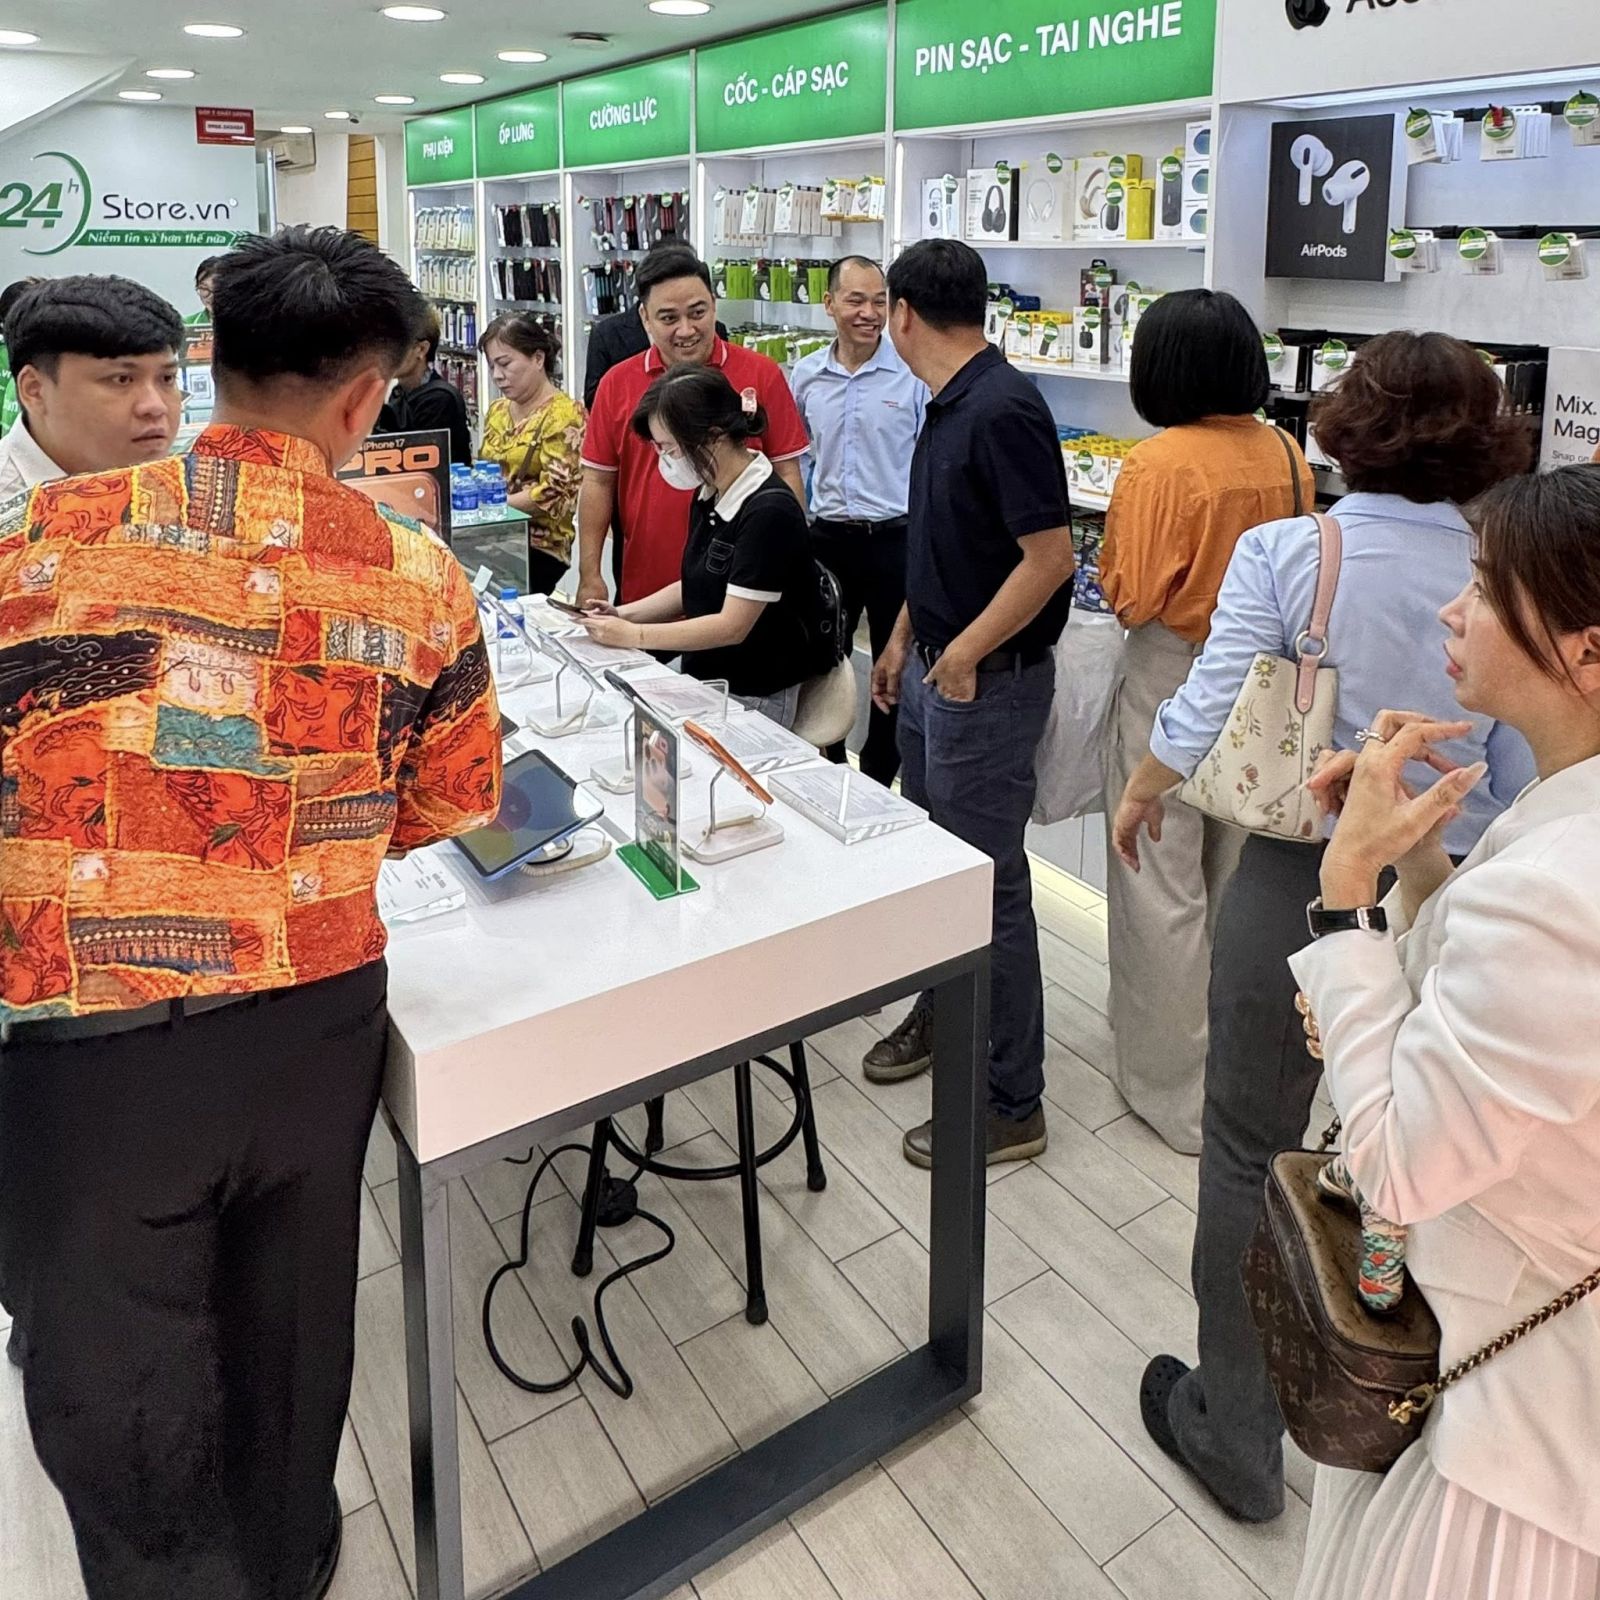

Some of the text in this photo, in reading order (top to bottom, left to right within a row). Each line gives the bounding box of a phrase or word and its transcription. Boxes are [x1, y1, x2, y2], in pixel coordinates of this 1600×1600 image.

[915, 43, 954, 76] PIN
[960, 32, 1013, 74] SẠC
[1035, 19, 1080, 57] TAI
[1088, 1, 1182, 50] NGHE
[724, 71, 759, 106] CỐC
[772, 65, 807, 98] CÁP
[811, 61, 849, 96] SẠC
[589, 96, 657, 130] CƯỜNG LỰC
[499, 122, 510, 145] ỐP
[125, 232, 140, 243] tin
[1300, 244, 1347, 258] AirPods
[1556, 394, 1597, 416] Mix.
[364, 438, 405, 450] iPhone 17
